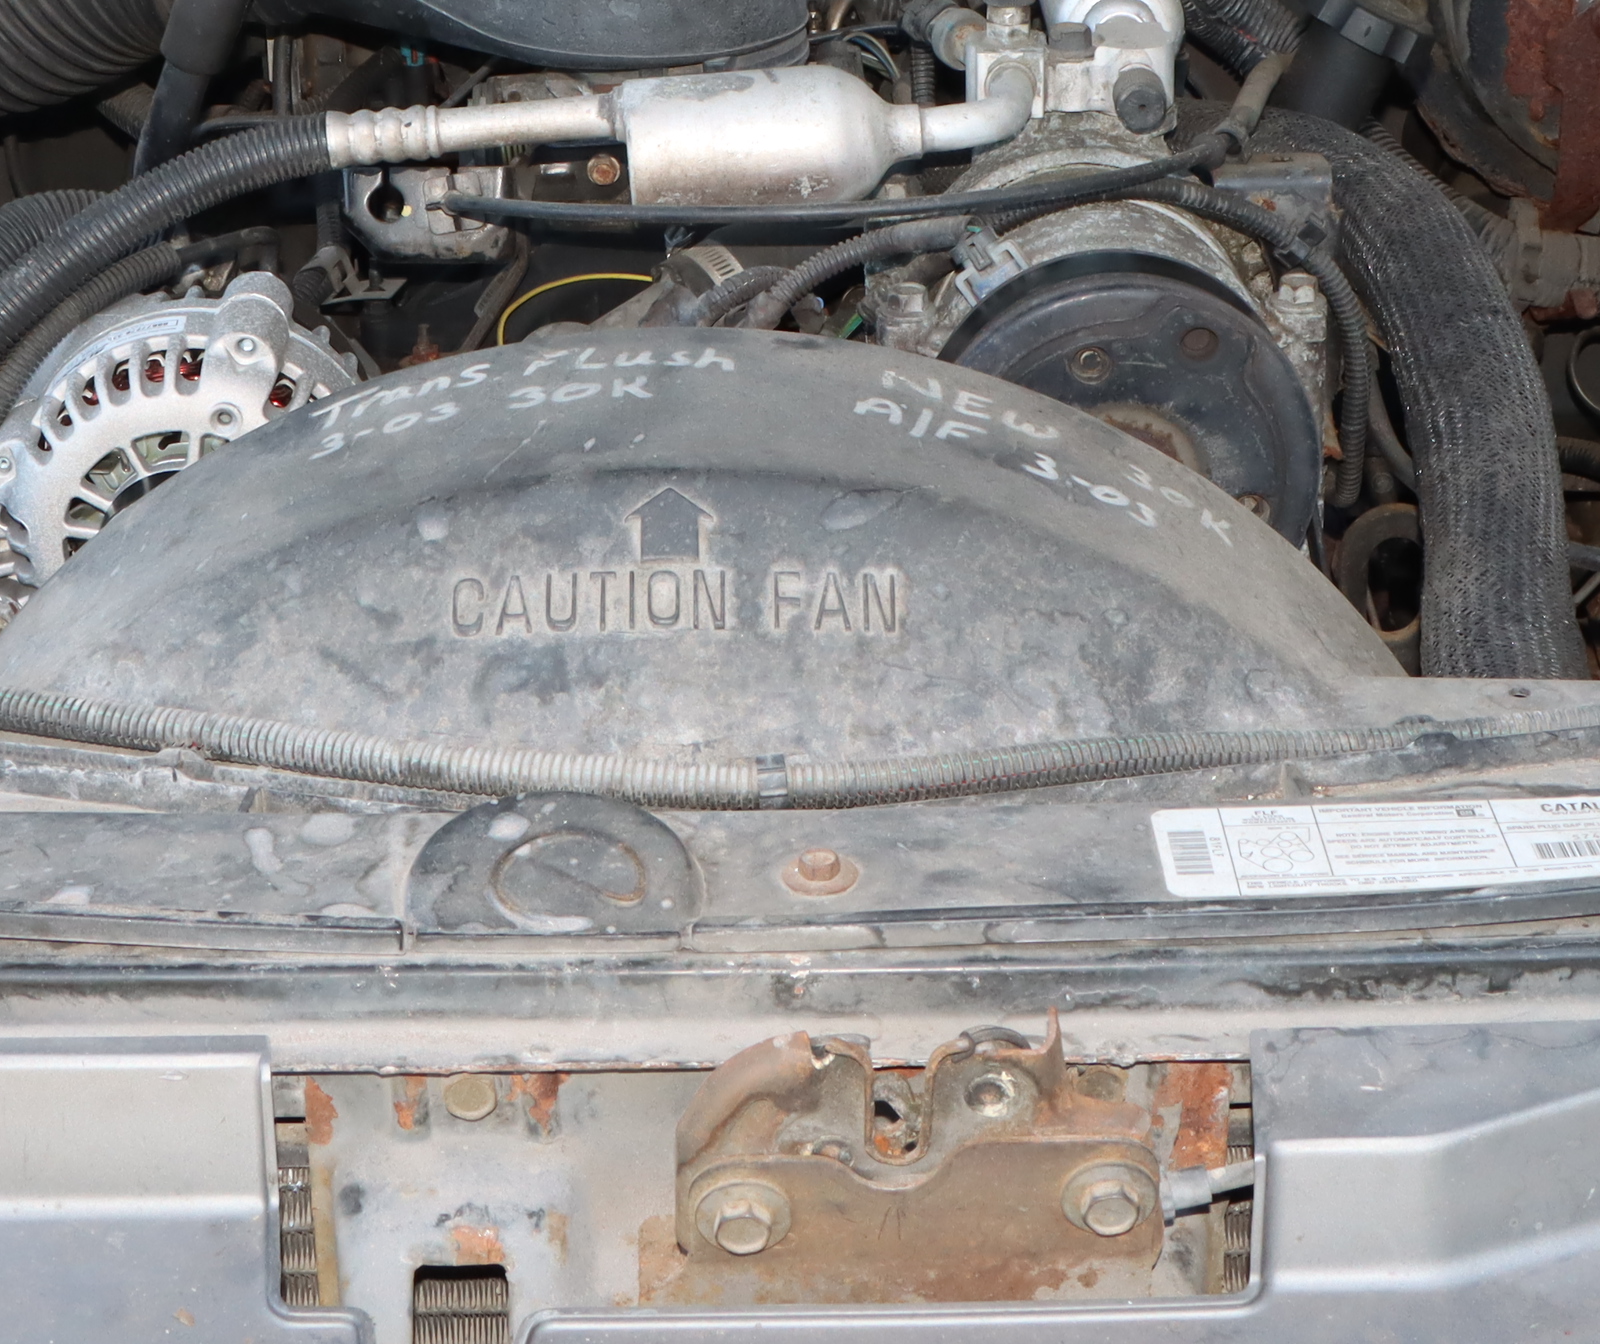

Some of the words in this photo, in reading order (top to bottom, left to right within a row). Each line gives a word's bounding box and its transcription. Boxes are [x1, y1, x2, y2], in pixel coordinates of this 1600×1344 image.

[309, 402, 462, 460] 3-03
[507, 375, 654, 409] 30K
[1021, 452, 1158, 528] 3-03
[451, 570, 727, 638] CAUTION
[773, 570, 898, 634] FAN
